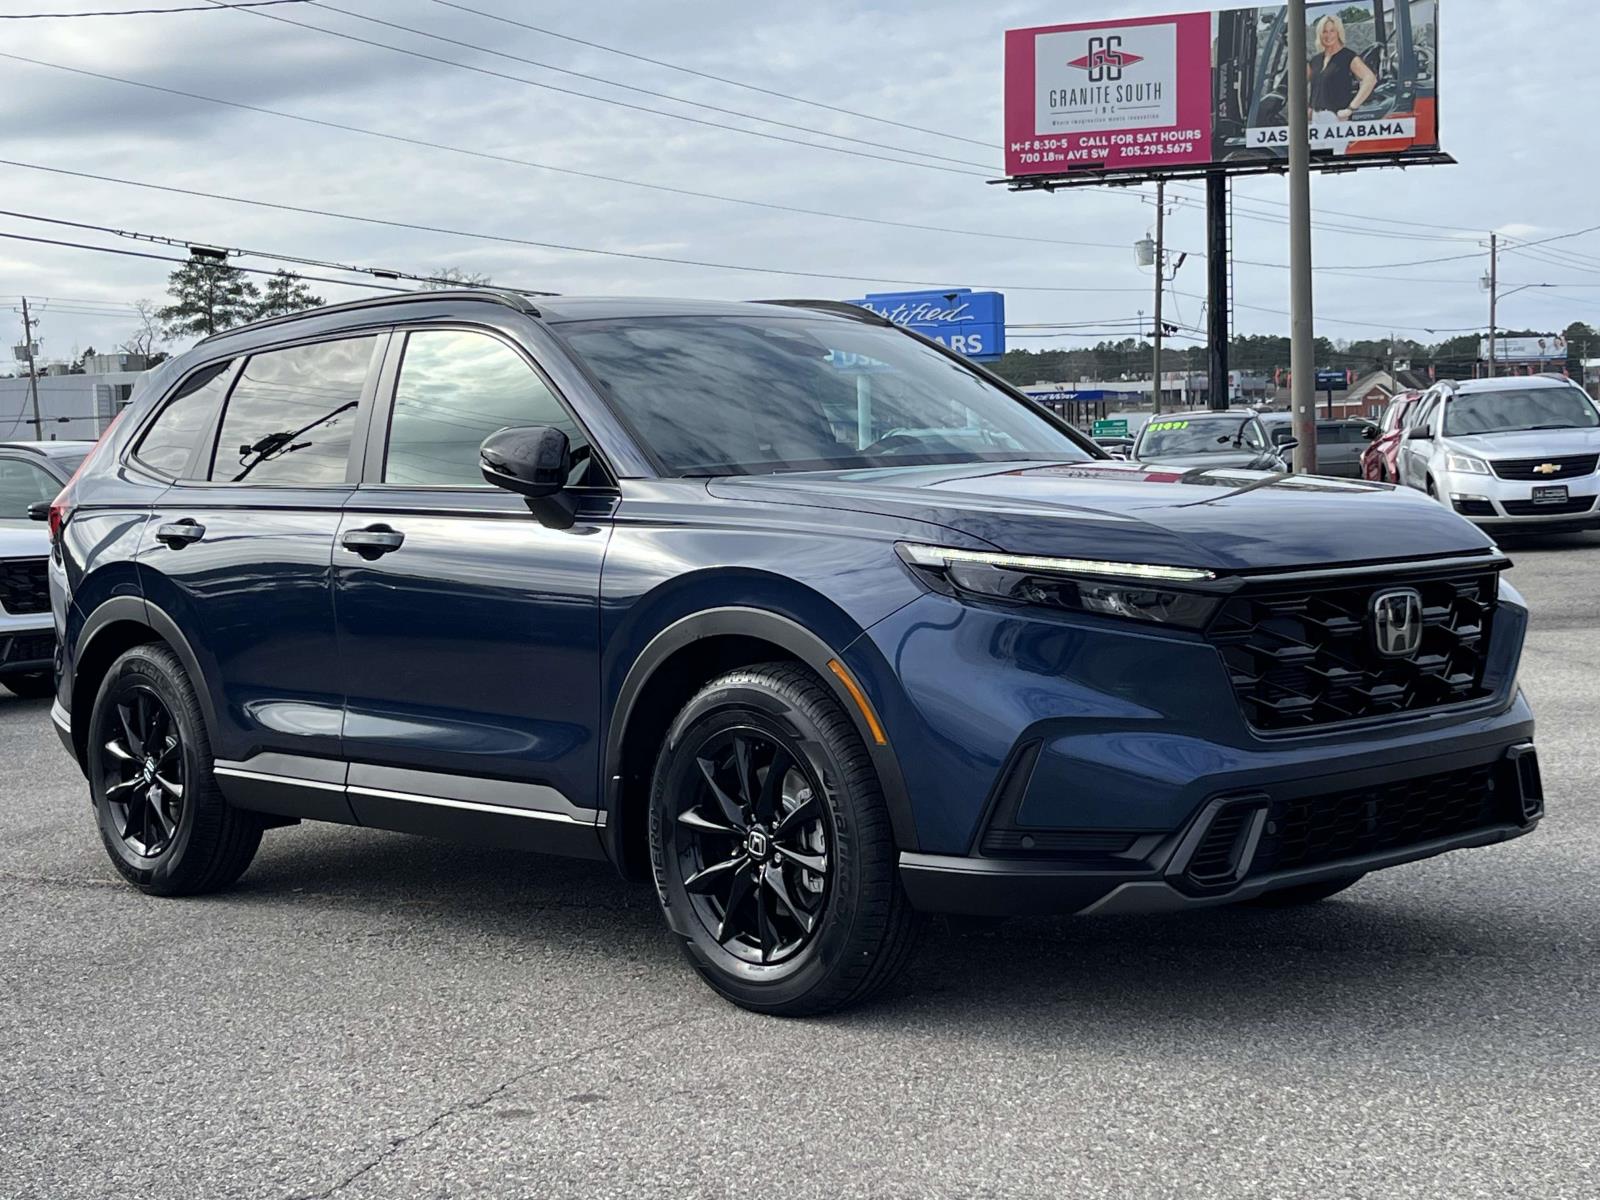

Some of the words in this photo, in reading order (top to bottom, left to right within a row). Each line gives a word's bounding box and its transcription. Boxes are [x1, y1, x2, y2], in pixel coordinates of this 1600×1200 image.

[1088, 35, 1122, 82] GS
[1049, 86, 1110, 108] GRANITE
[1116, 82, 1162, 103] SOUTH
[1095, 106, 1115, 114] INC
[1011, 141, 1031, 152] M-F
[1033, 139, 1068, 150] 8:30-5
[1079, 136, 1109, 147] CALL
[1110, 134, 1134, 145] FOR
[1136, 132, 1158, 143] SAT
[1160, 130, 1201, 141] HOURS
[1256, 127, 1318, 144] JASR
[1323, 122, 1404, 139] ALABAMA
[1020, 153, 1040, 164] 700
[1067, 149, 1088, 160] AVE
[1091, 148, 1109, 159] SW
[1120, 142, 1193, 157] 205.295.5675
[861, 302, 975, 328] rtified
